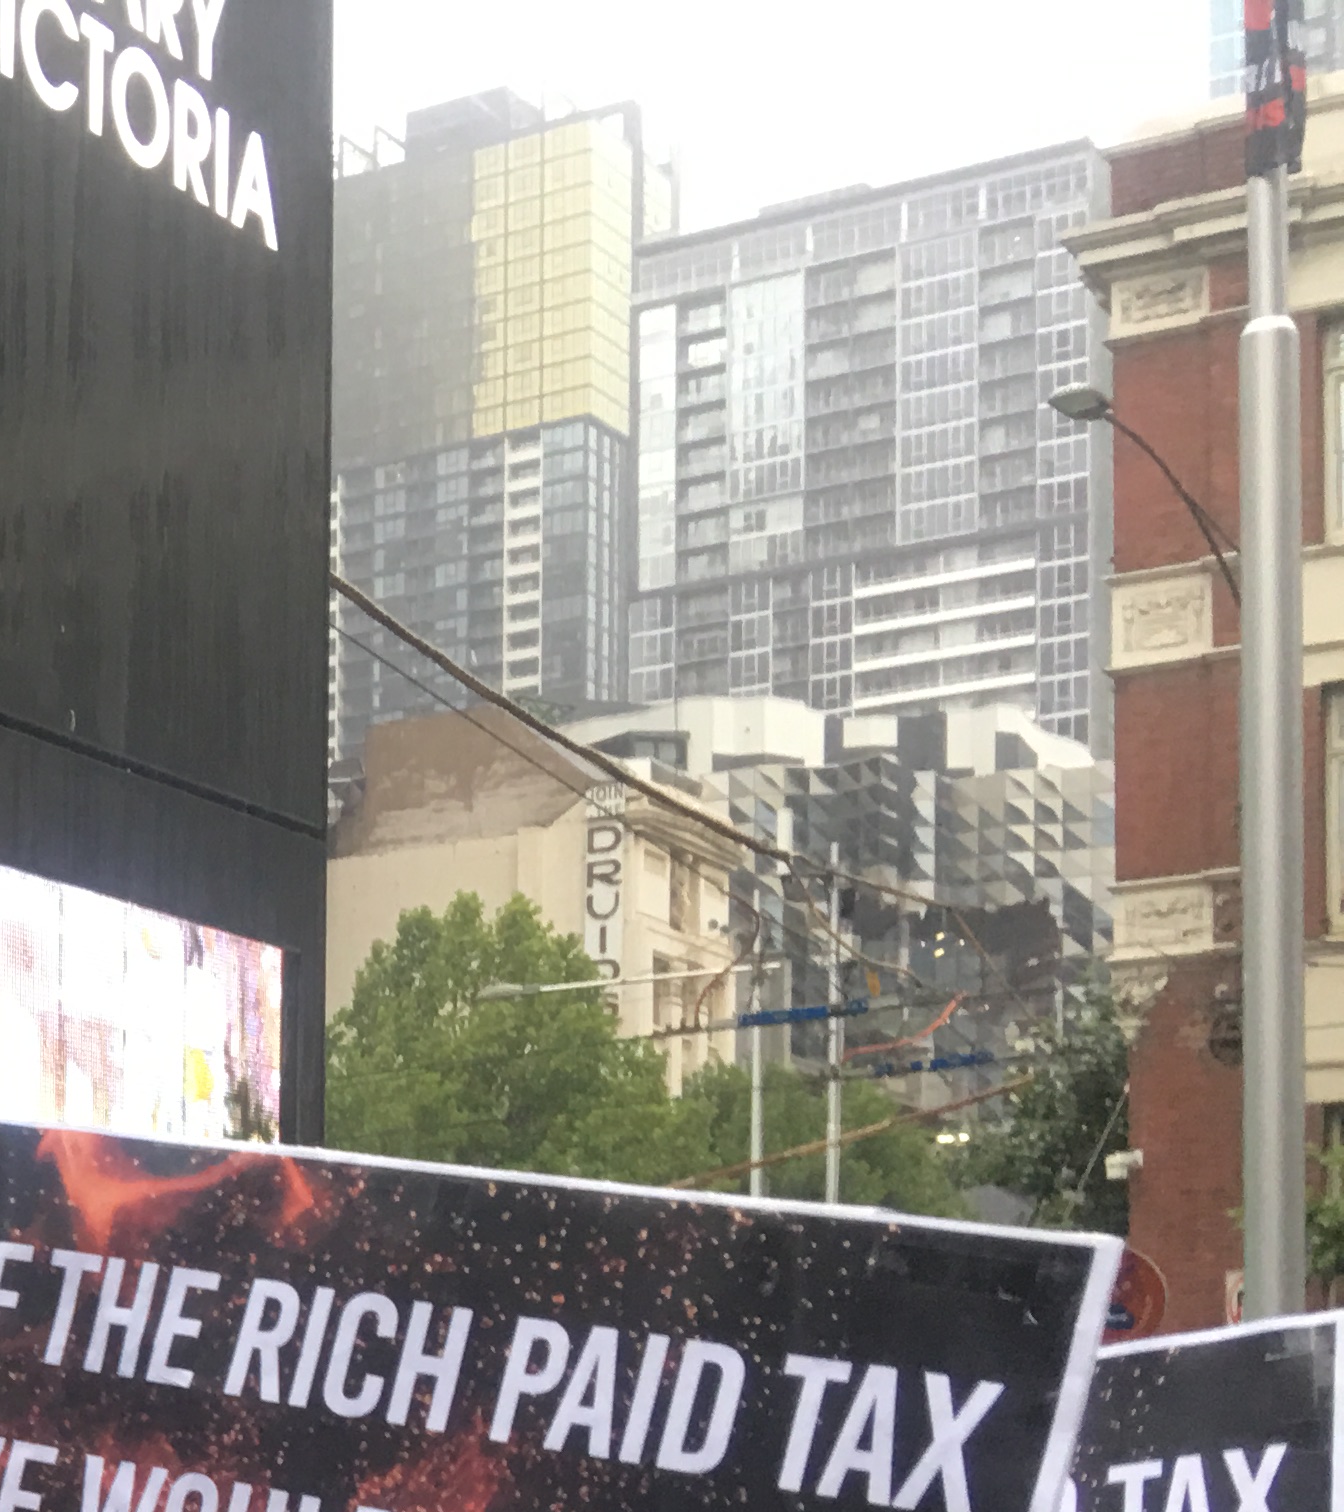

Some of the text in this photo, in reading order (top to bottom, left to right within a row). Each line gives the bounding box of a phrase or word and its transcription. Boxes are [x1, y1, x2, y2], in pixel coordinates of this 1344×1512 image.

[45, 1251, 221, 1388] THE
[223, 1279, 473, 1432] RICH
[490, 1317, 745, 1473] PAID
